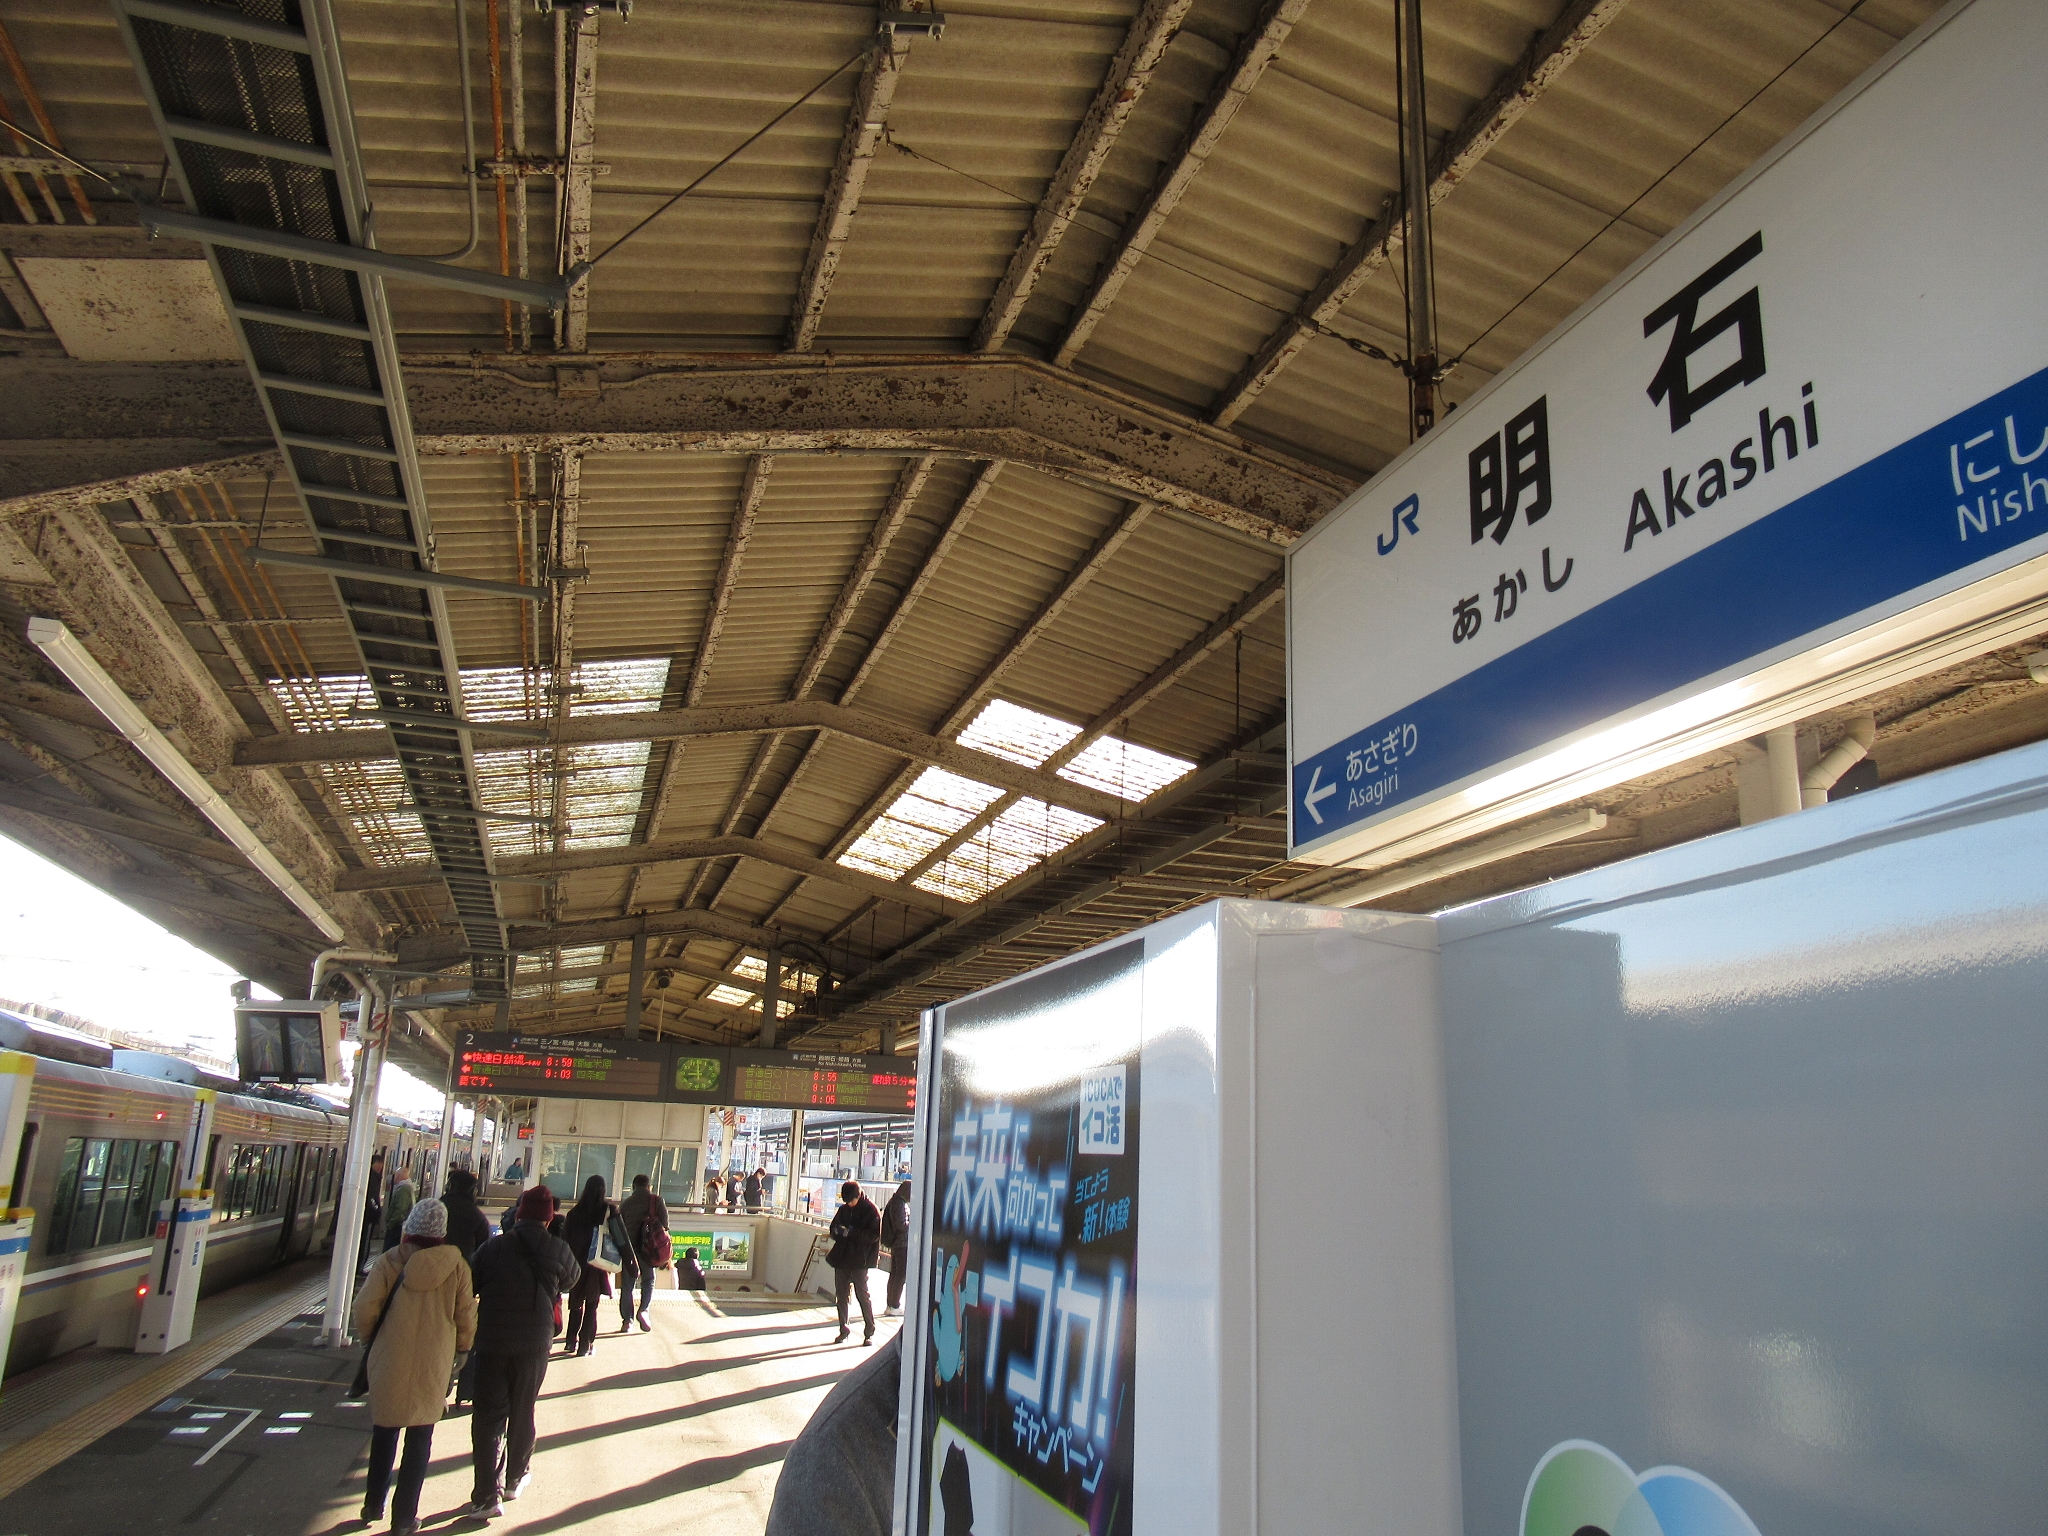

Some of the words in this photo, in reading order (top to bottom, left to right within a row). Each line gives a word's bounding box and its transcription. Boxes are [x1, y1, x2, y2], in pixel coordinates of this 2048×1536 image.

[1469, 230, 1767, 546] 明石
[1623, 381, 1820, 553] Akashi
[1950, 415, 2048, 496] にし
[1377, 493, 1420, 556] JR
[1957, 471, 2048, 542] Nish
[1452, 547, 1574, 645] あかし
[1345, 723, 1419, 783] あさぎり
[1347, 766, 1400, 811] Asagiri
[465, 1033, 474, 1045] 2
[813, 1071, 837, 1082] 8:55
[1081, 1103, 1121, 1145] イコ活
[1004, 1175, 1066, 1233] 向かって
[1013, 1401, 1104, 1494] キャンペーン
